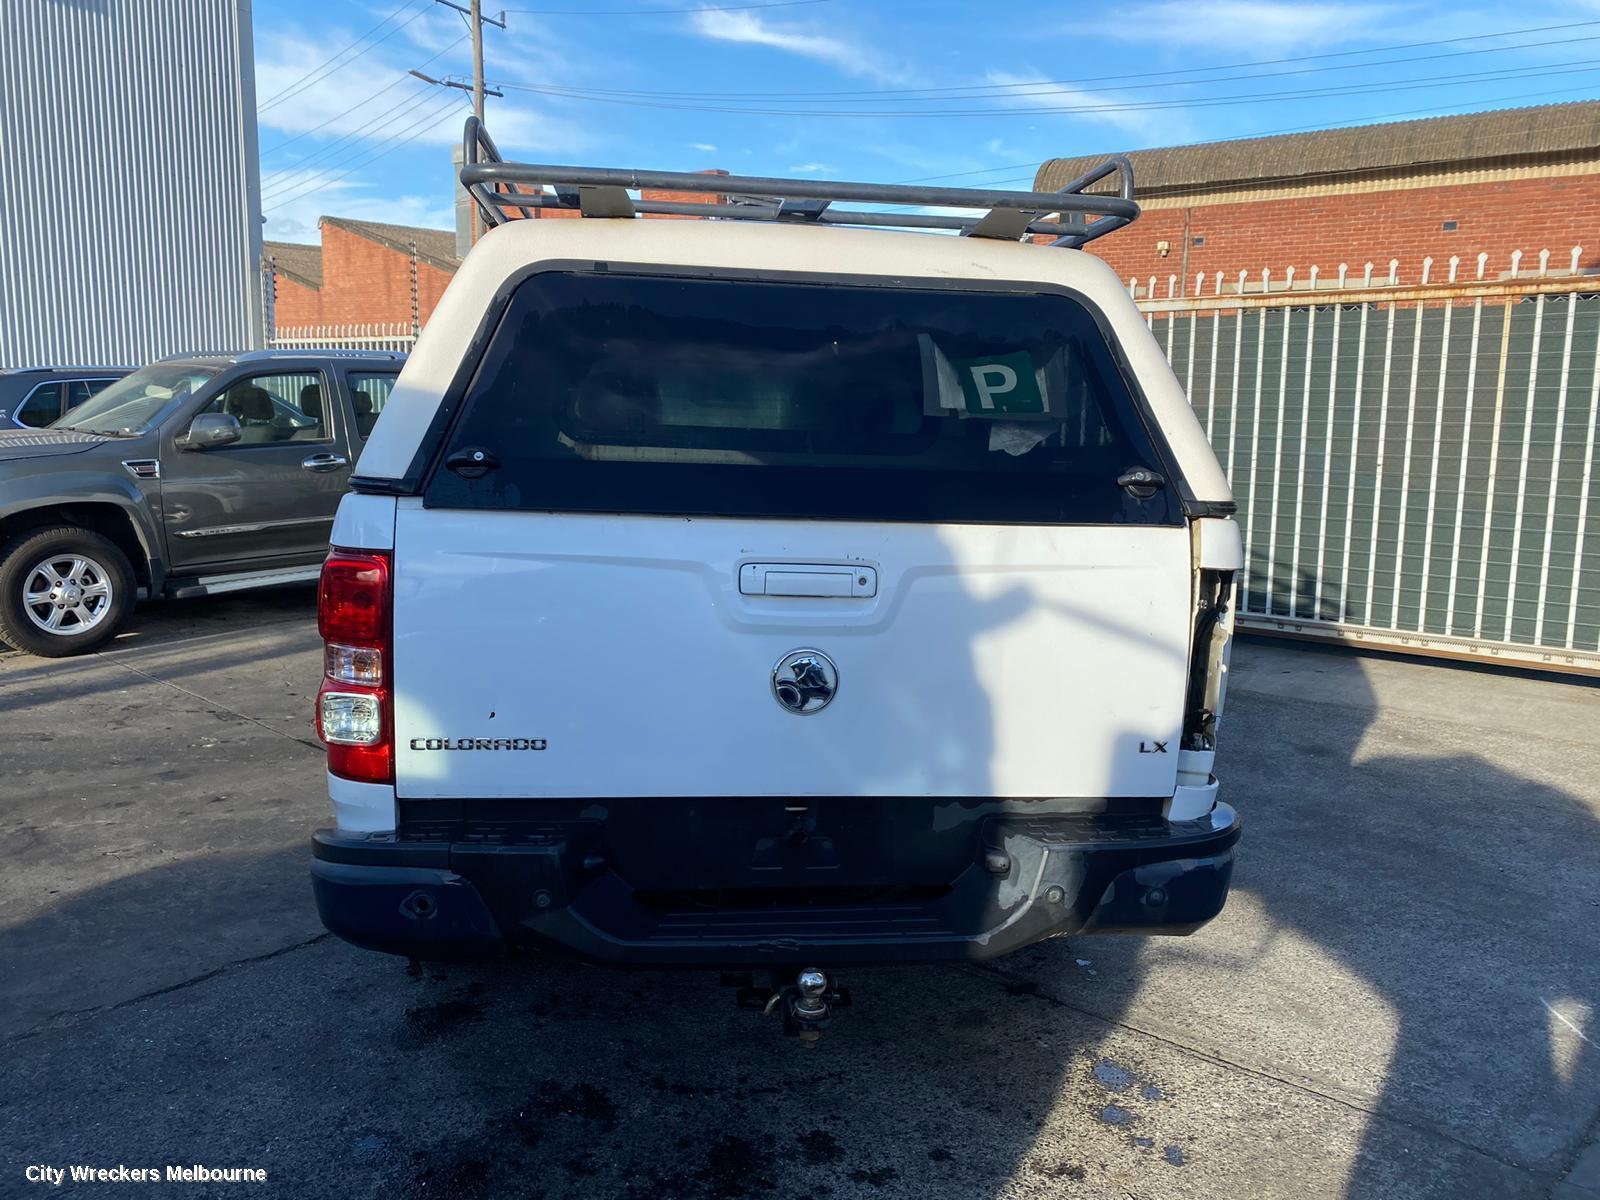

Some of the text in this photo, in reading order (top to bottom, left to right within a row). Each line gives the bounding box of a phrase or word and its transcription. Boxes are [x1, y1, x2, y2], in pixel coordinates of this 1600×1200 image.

[969, 364, 1018, 409] P
[410, 737, 547, 751] COLORADO
[1139, 741, 1168, 753] LX
